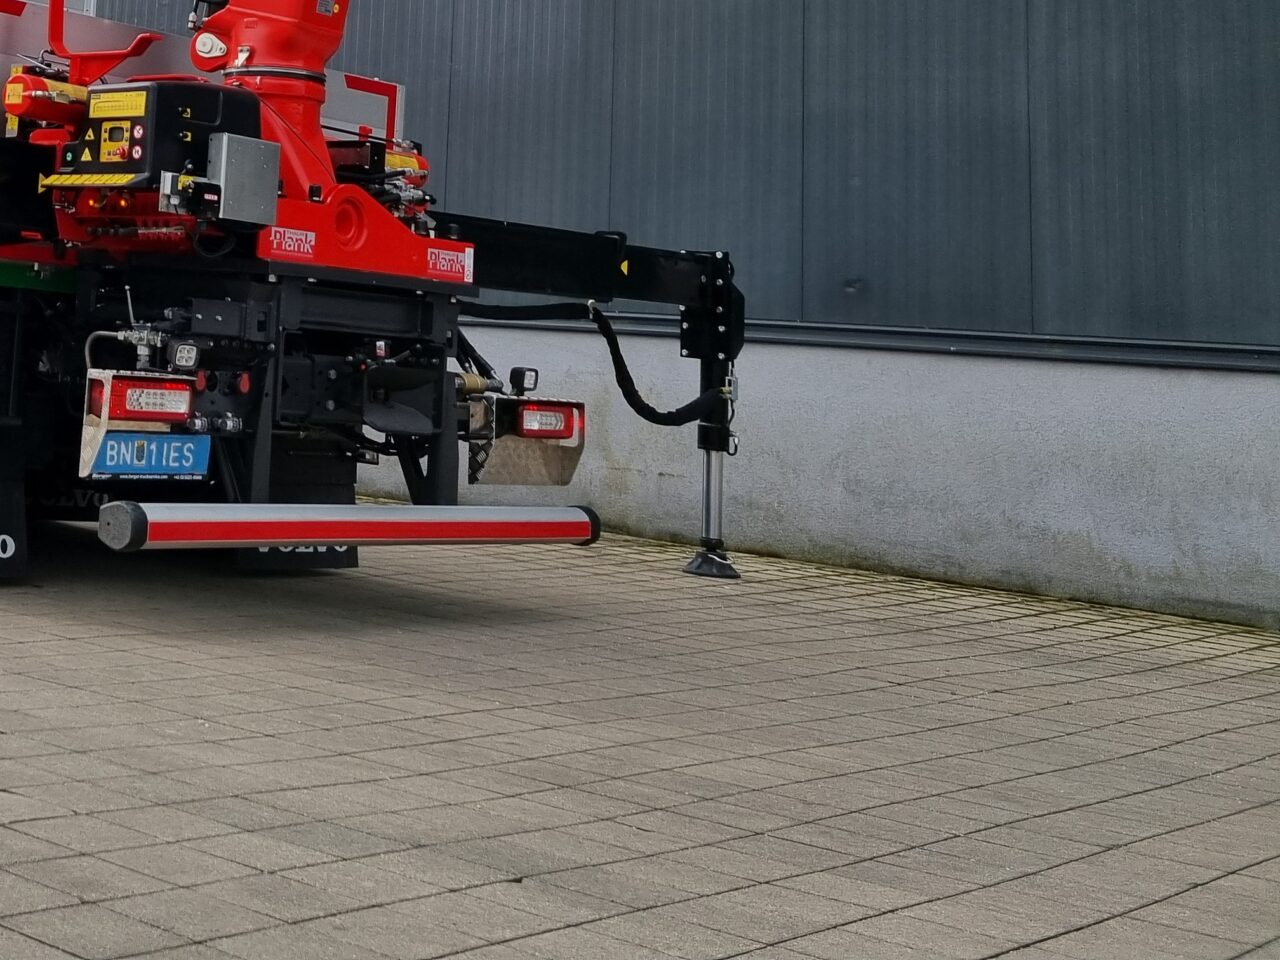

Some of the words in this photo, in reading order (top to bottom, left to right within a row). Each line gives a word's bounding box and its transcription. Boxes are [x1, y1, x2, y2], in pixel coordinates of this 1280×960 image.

[273, 229, 312, 254] Plank
[429, 250, 464, 273] Plank
[106, 440, 131, 466] BN
